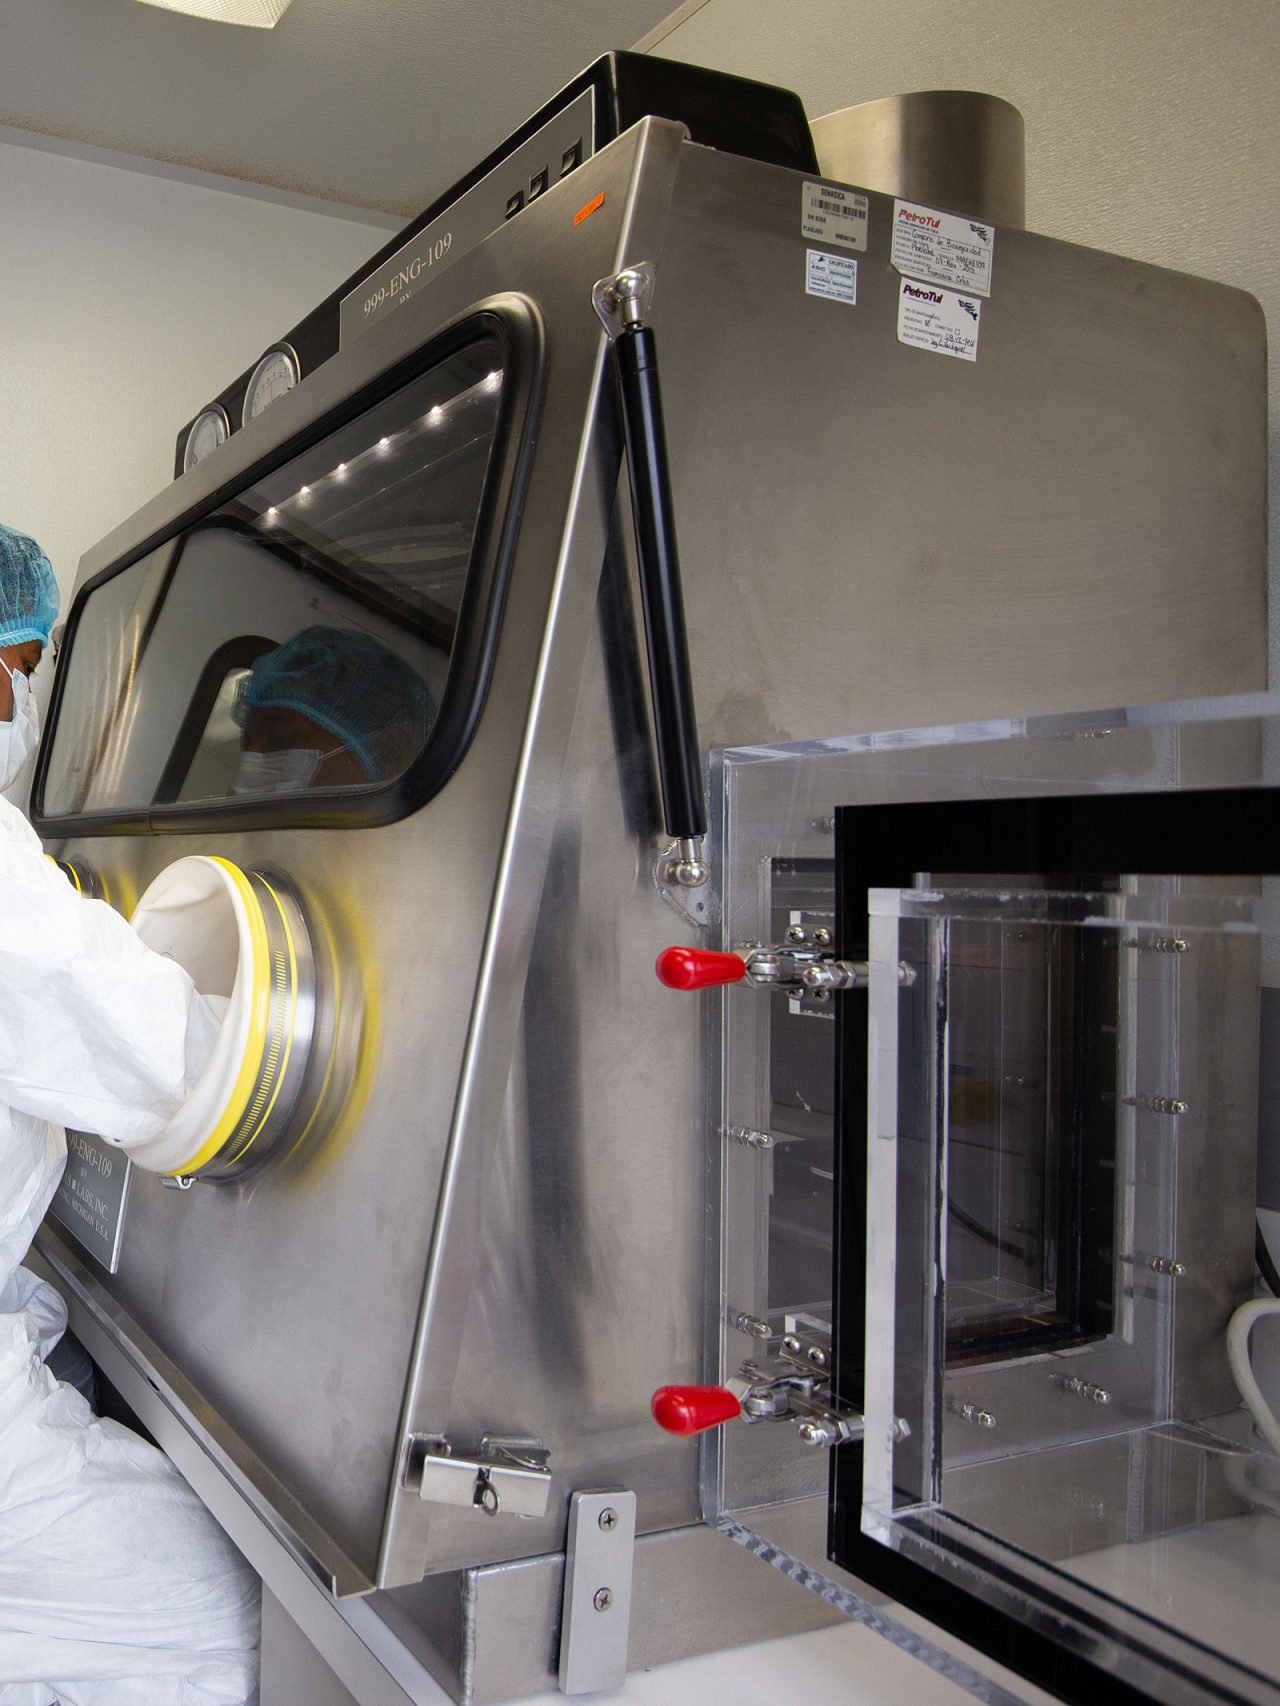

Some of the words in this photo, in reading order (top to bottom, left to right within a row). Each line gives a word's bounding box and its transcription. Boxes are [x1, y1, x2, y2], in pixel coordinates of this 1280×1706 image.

[821, 188, 845, 200] SENASICA
[899, 209, 941, 229] PetroTul
[364, 232, 452, 318] 999-ENG-109
[903, 284, 943, 304] PetroTul
[94, 1197, 109, 1223] INC.
